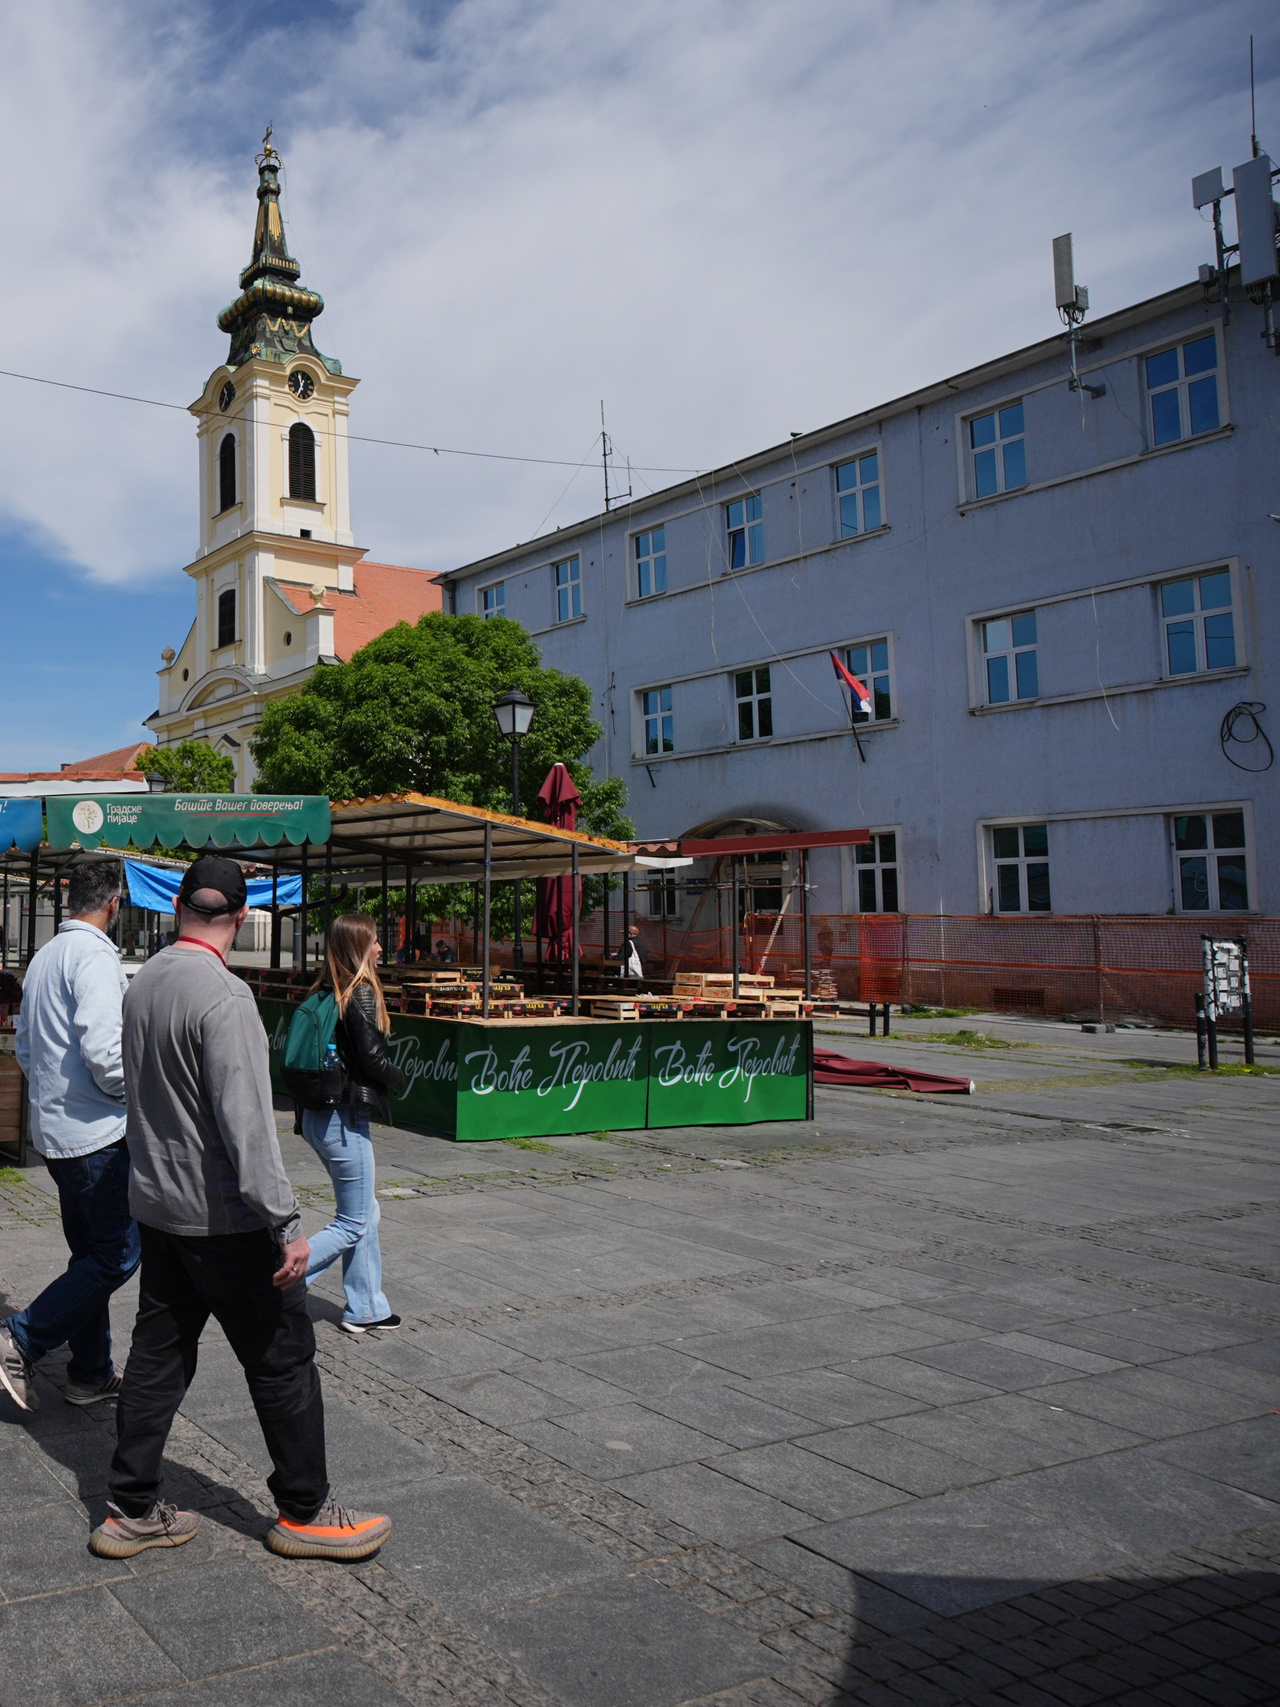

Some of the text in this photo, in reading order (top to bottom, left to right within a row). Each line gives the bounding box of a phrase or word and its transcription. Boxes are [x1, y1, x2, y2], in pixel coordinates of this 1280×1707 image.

[106, 803, 142, 816] Градске
[215, 799, 247, 811] Вашег
[107, 813, 138, 826] пијаце
[387, 1031, 458, 1101] Перови
